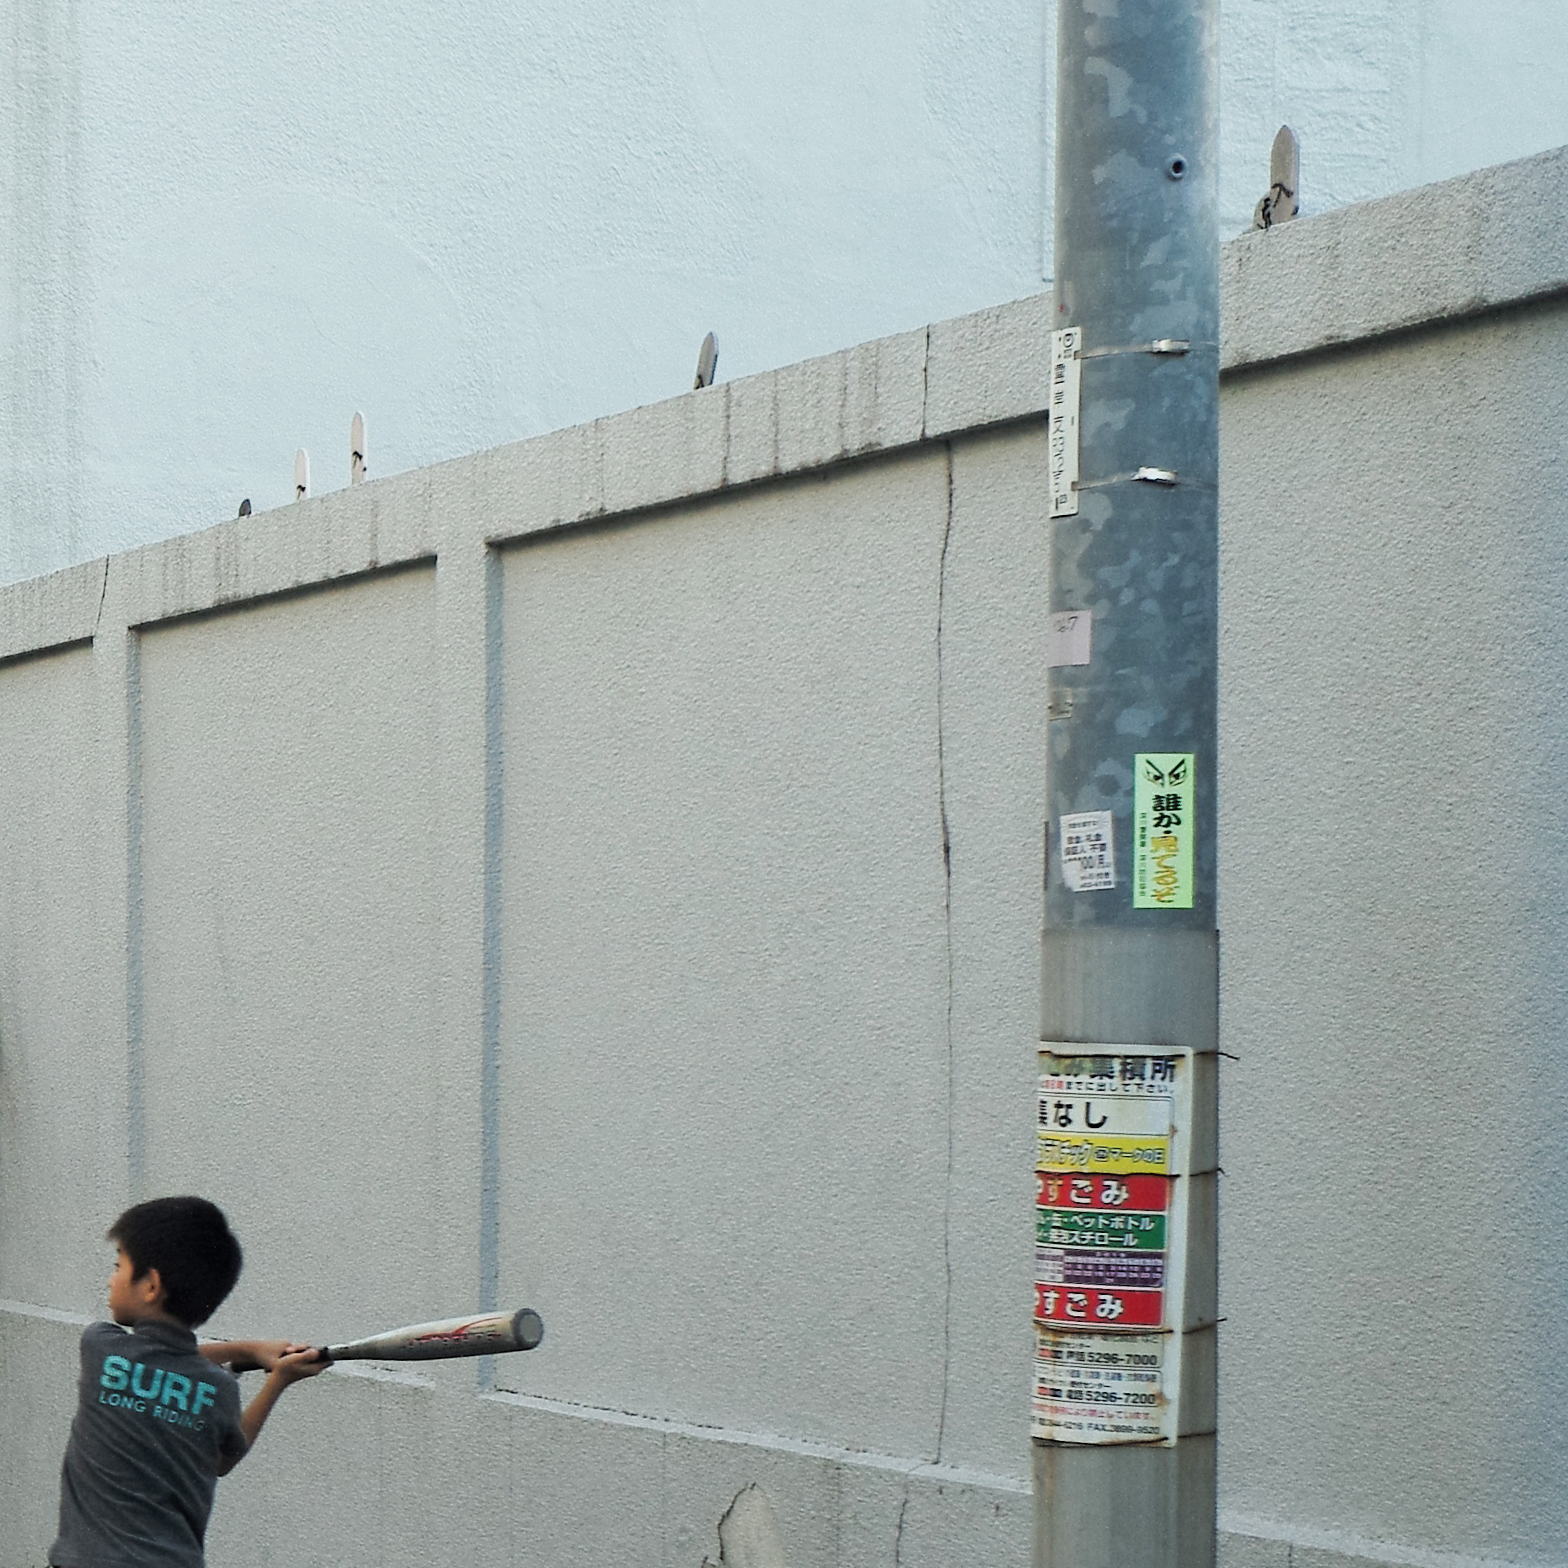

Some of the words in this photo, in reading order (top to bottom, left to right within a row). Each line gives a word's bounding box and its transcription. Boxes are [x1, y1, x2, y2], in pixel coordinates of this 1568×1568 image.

[98, 1354, 217, 1415] SURF
[99, 1390, 146, 1414] LONG
[152, 1404, 206, 1432] RIDING
